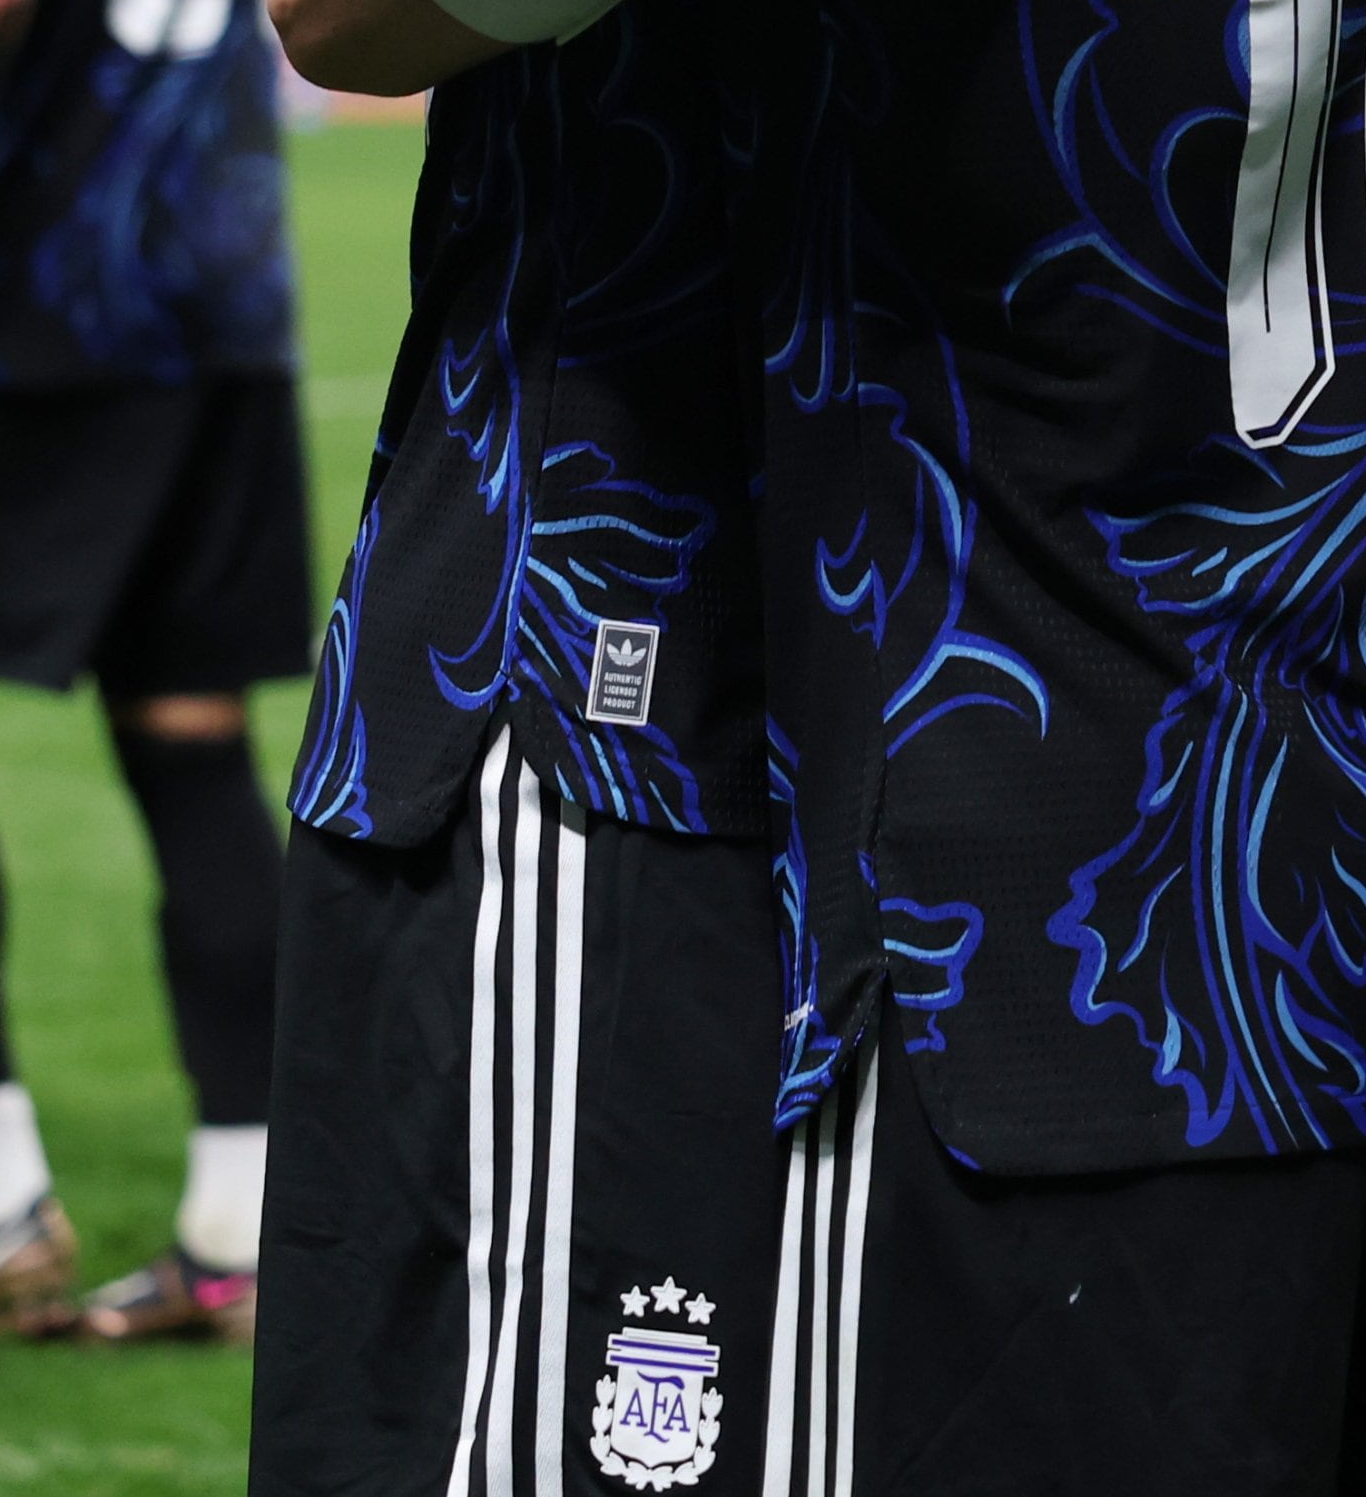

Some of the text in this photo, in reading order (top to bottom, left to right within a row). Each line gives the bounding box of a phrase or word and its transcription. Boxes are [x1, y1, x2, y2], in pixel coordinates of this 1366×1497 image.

[604, 672, 642, 685] AUTHENTIC
[604, 685, 638, 696] LICENSED
[603, 697, 636, 709] PRODUCT
[619, 1370, 691, 1443] AFA
